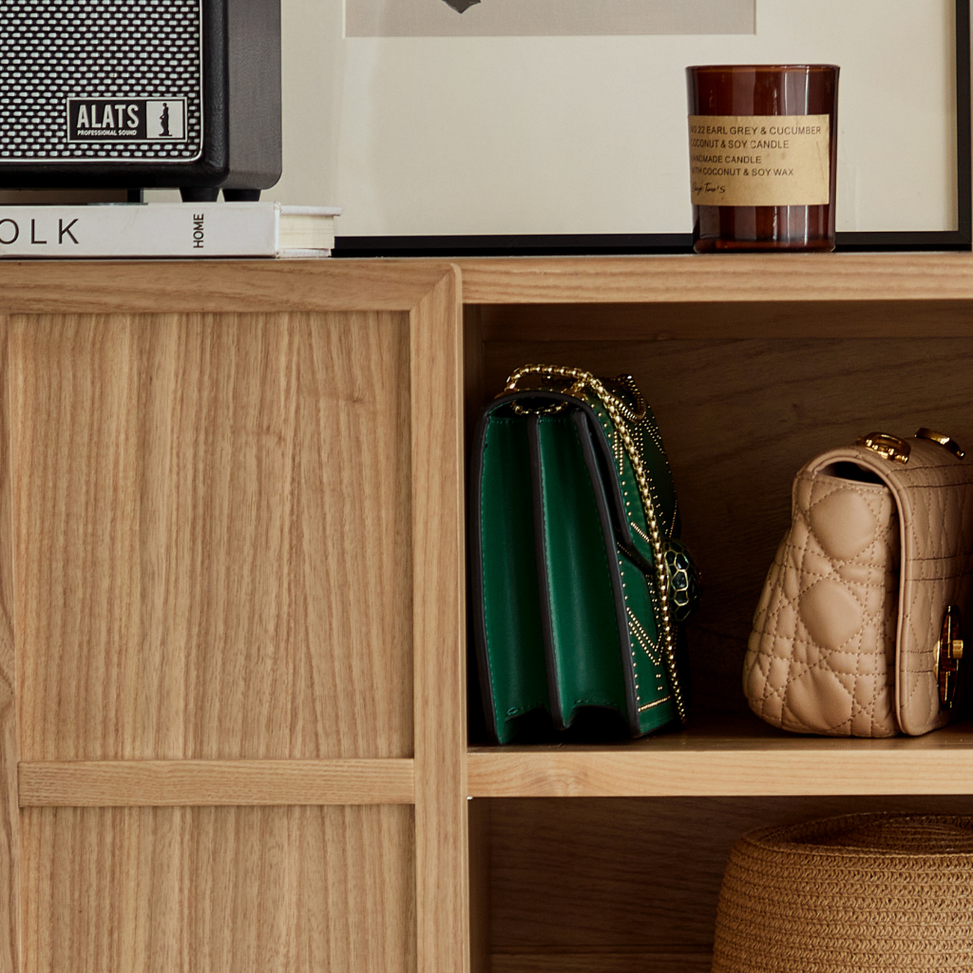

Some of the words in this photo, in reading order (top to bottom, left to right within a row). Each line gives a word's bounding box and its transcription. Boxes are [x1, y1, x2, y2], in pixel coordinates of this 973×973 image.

[77, 104, 139, 128] ALATS
[706, 126, 728, 135] EARL
[729, 126, 758, 135] GREY
[760, 126, 767, 135] &
[768, 126, 821, 135] CUCUMBER
[720, 139, 727, 149] &
[728, 139, 748, 149] SOY
[750, 139, 789, 149] CANDLE
[724, 155, 762, 164] CANDLE
[703, 167, 742, 176] COCONUT
[743, 168, 750, 176] &
[751, 168, 772, 176] SOY
[773, 168, 794, 176] WAX
[193, 213, 204, 248] HOME
